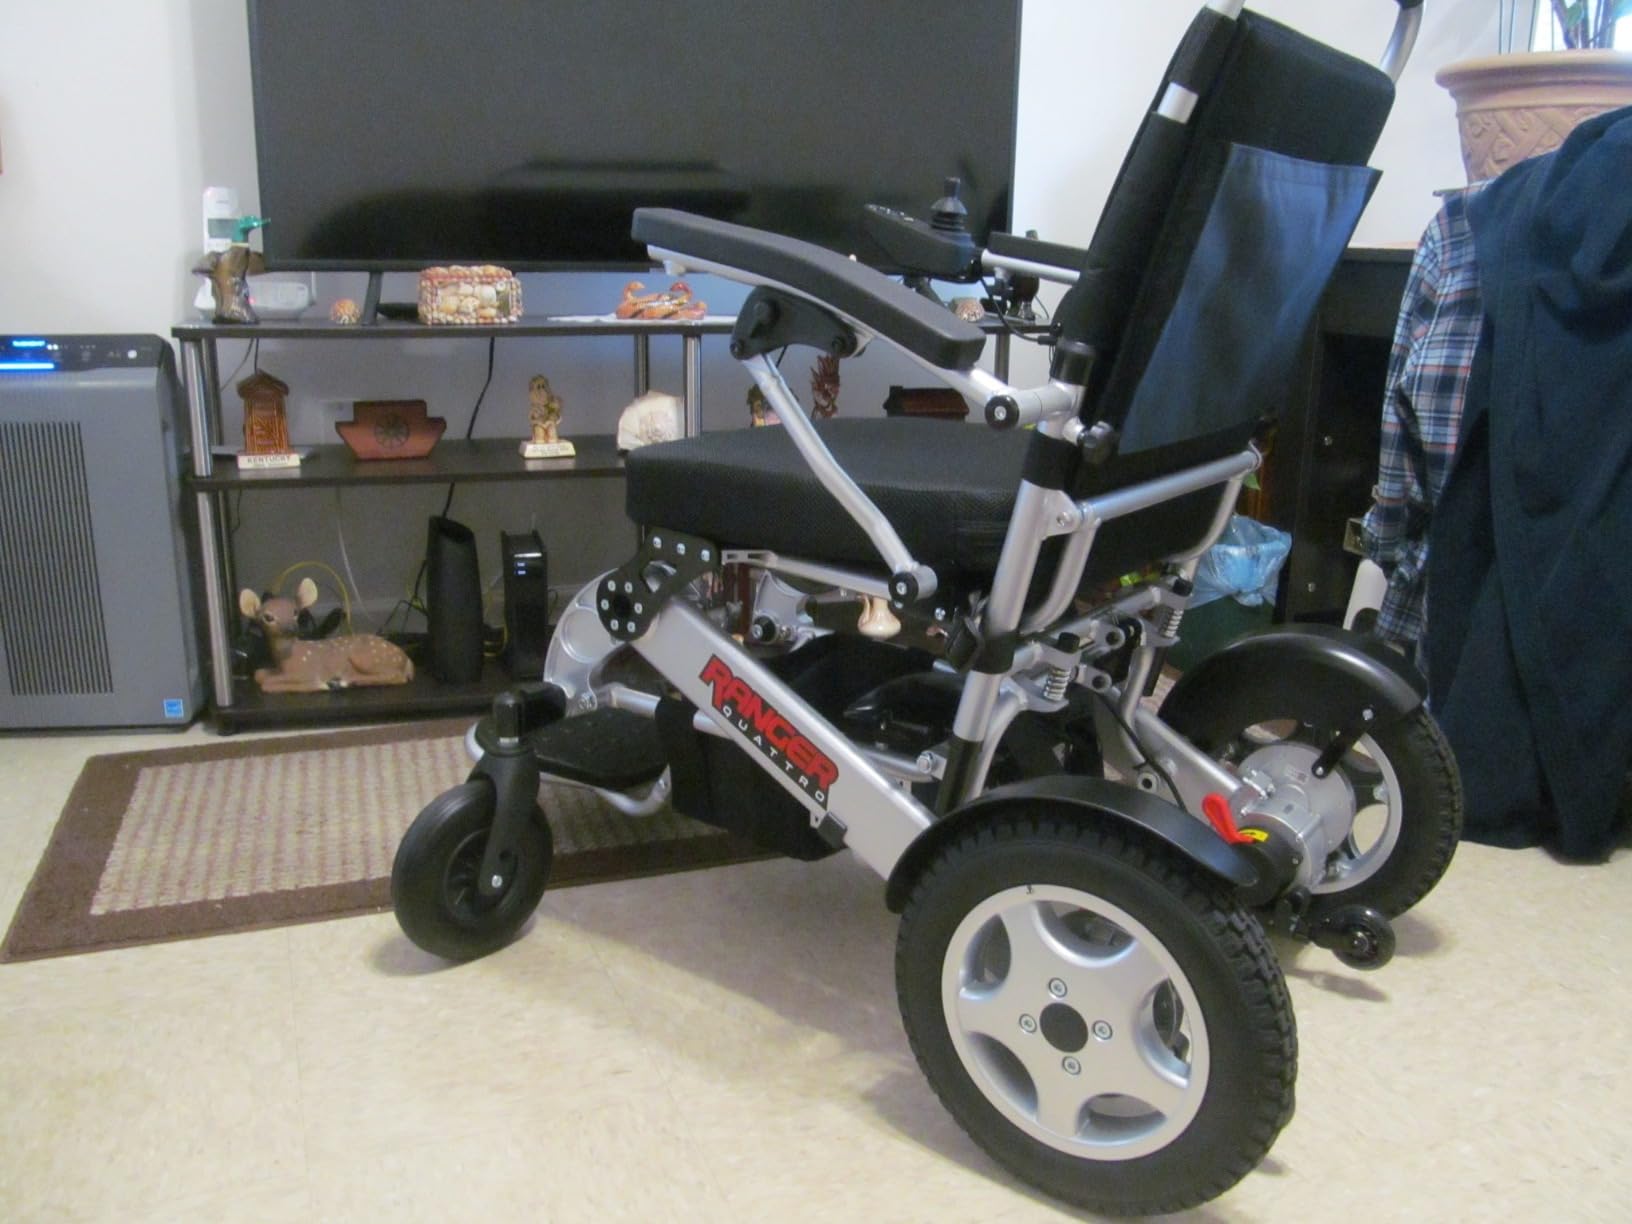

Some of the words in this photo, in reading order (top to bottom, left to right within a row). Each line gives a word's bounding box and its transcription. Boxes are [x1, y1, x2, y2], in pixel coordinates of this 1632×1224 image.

[246, 455, 290, 464] KENTUCKY
[699, 654, 839, 791] RANGER
[722, 705, 825, 802] QUATTRO
